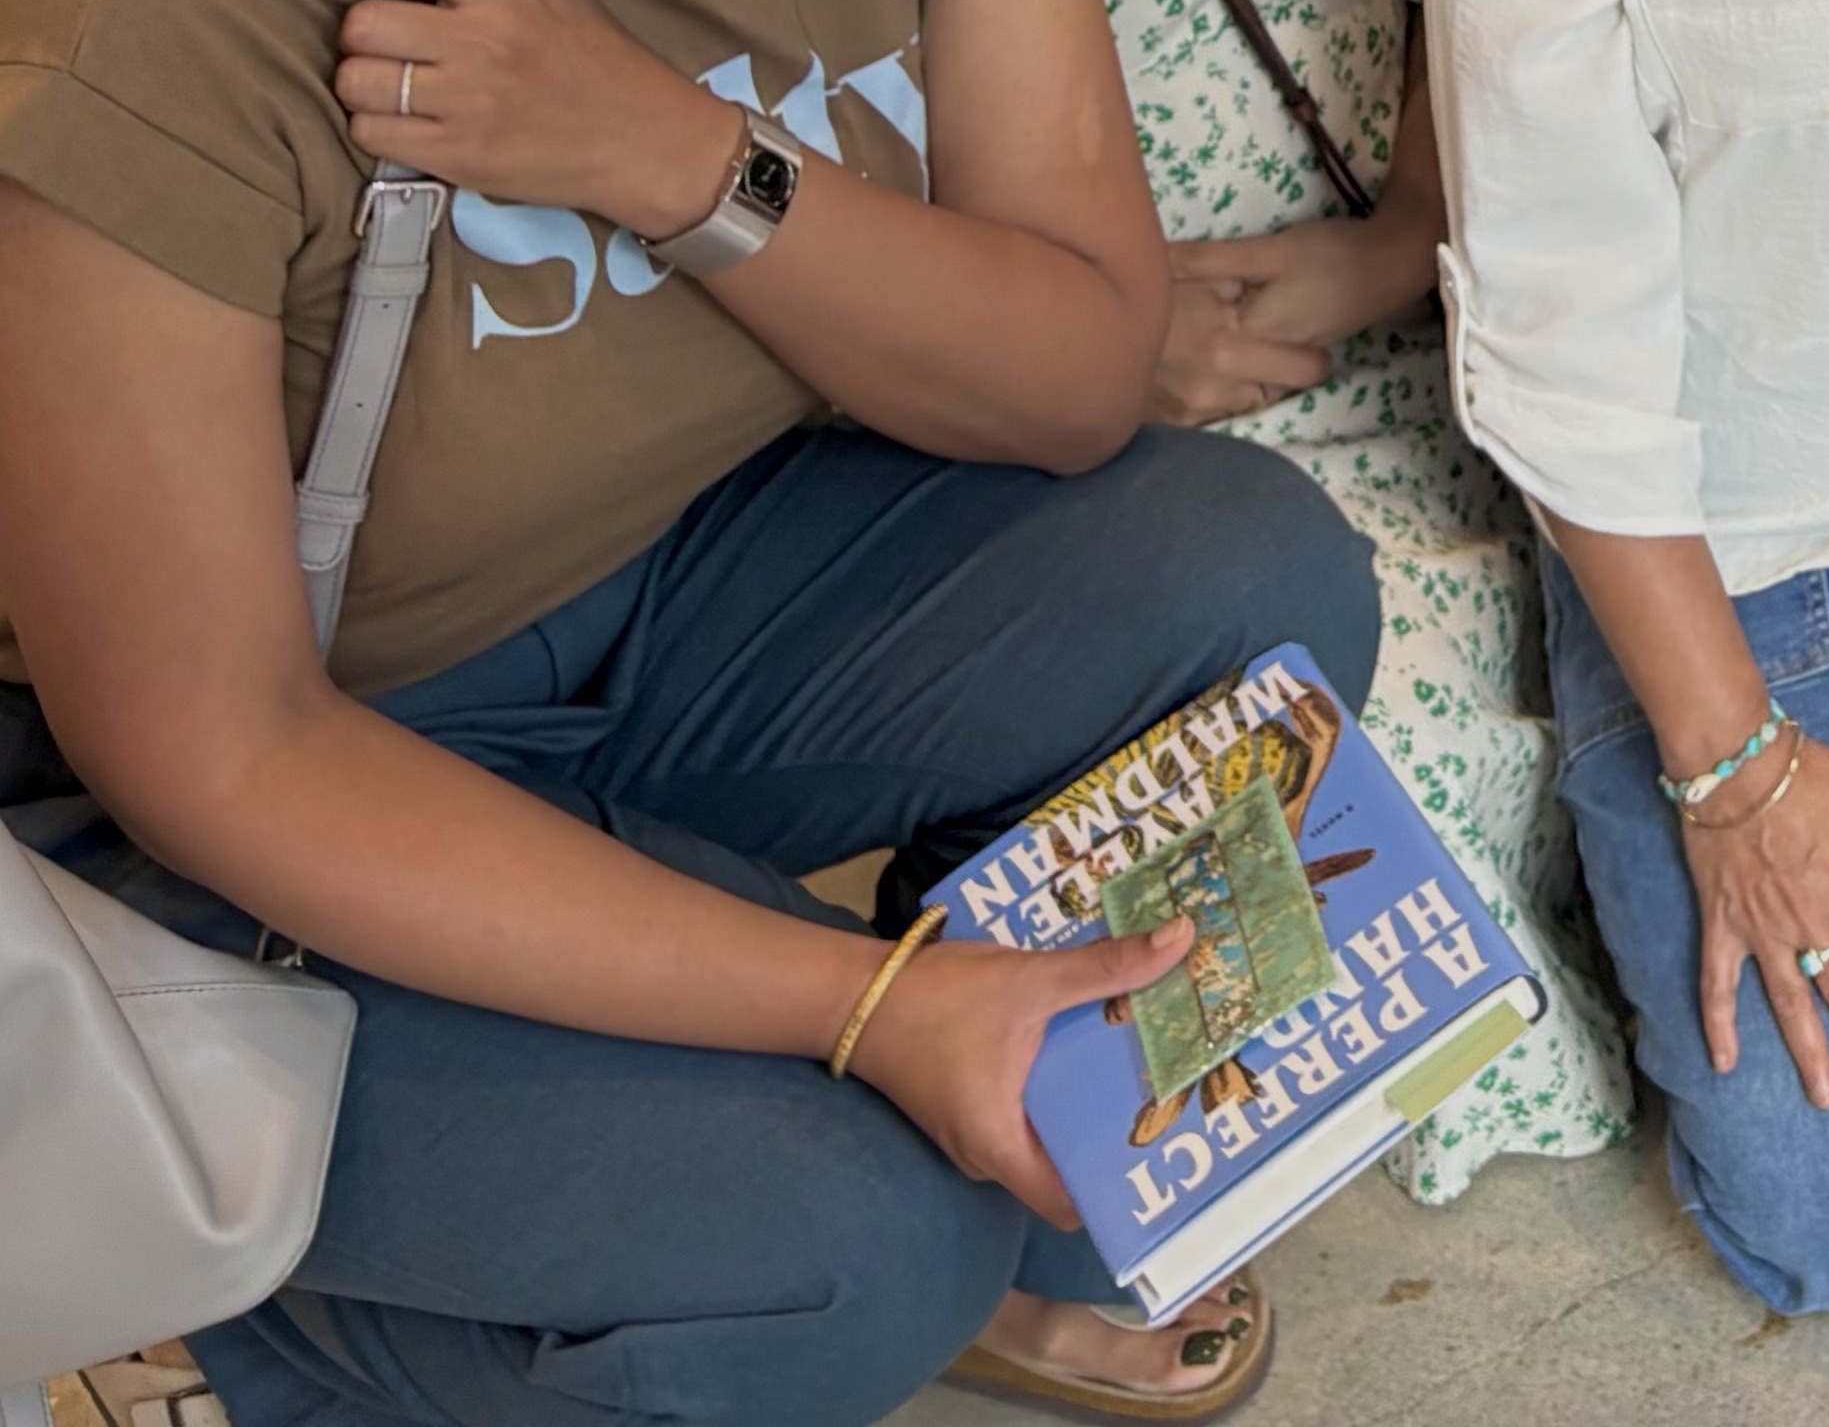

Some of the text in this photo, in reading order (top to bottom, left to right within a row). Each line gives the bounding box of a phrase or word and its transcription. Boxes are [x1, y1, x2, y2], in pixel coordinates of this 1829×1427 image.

[959, 659, 1310, 932] WALDMAN
[1125, 925, 1491, 1229] A PERFECT
